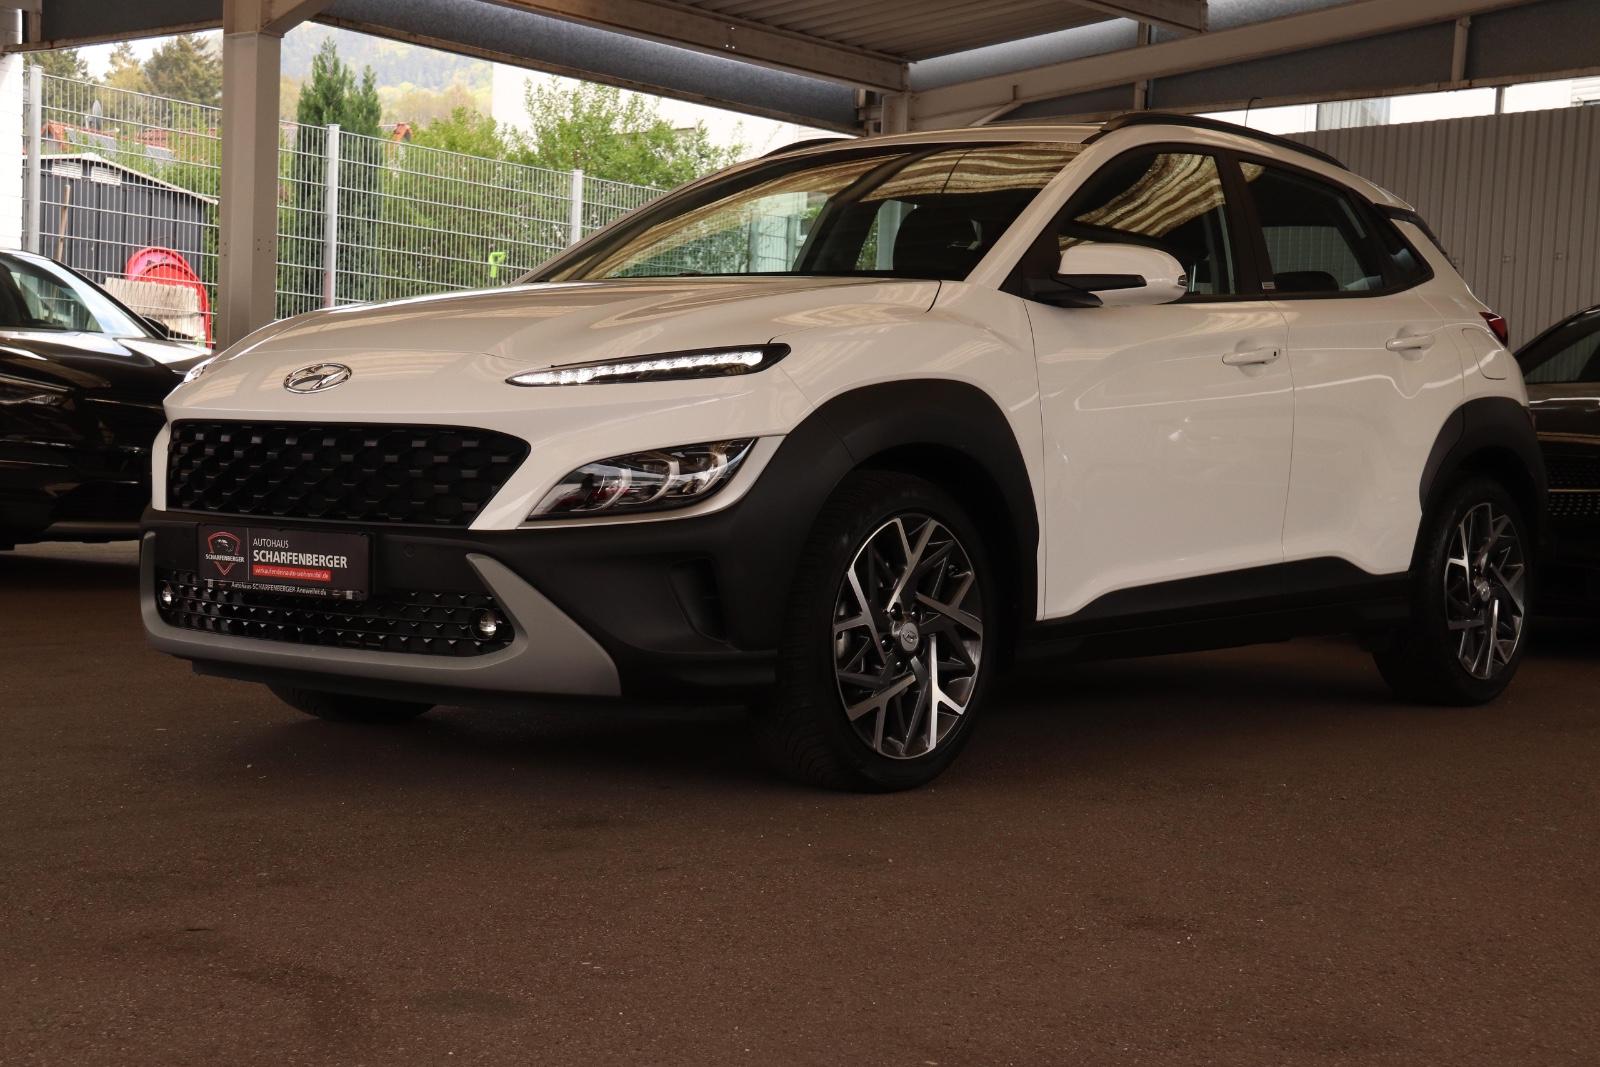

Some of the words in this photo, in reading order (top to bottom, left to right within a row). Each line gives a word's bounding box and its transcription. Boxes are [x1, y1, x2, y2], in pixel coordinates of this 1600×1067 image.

[253, 538, 289, 549] AUTOHAUS
[205, 553, 245, 562] SCHARFENBERGER
[253, 550, 348, 568] SCHARFENBERGER
